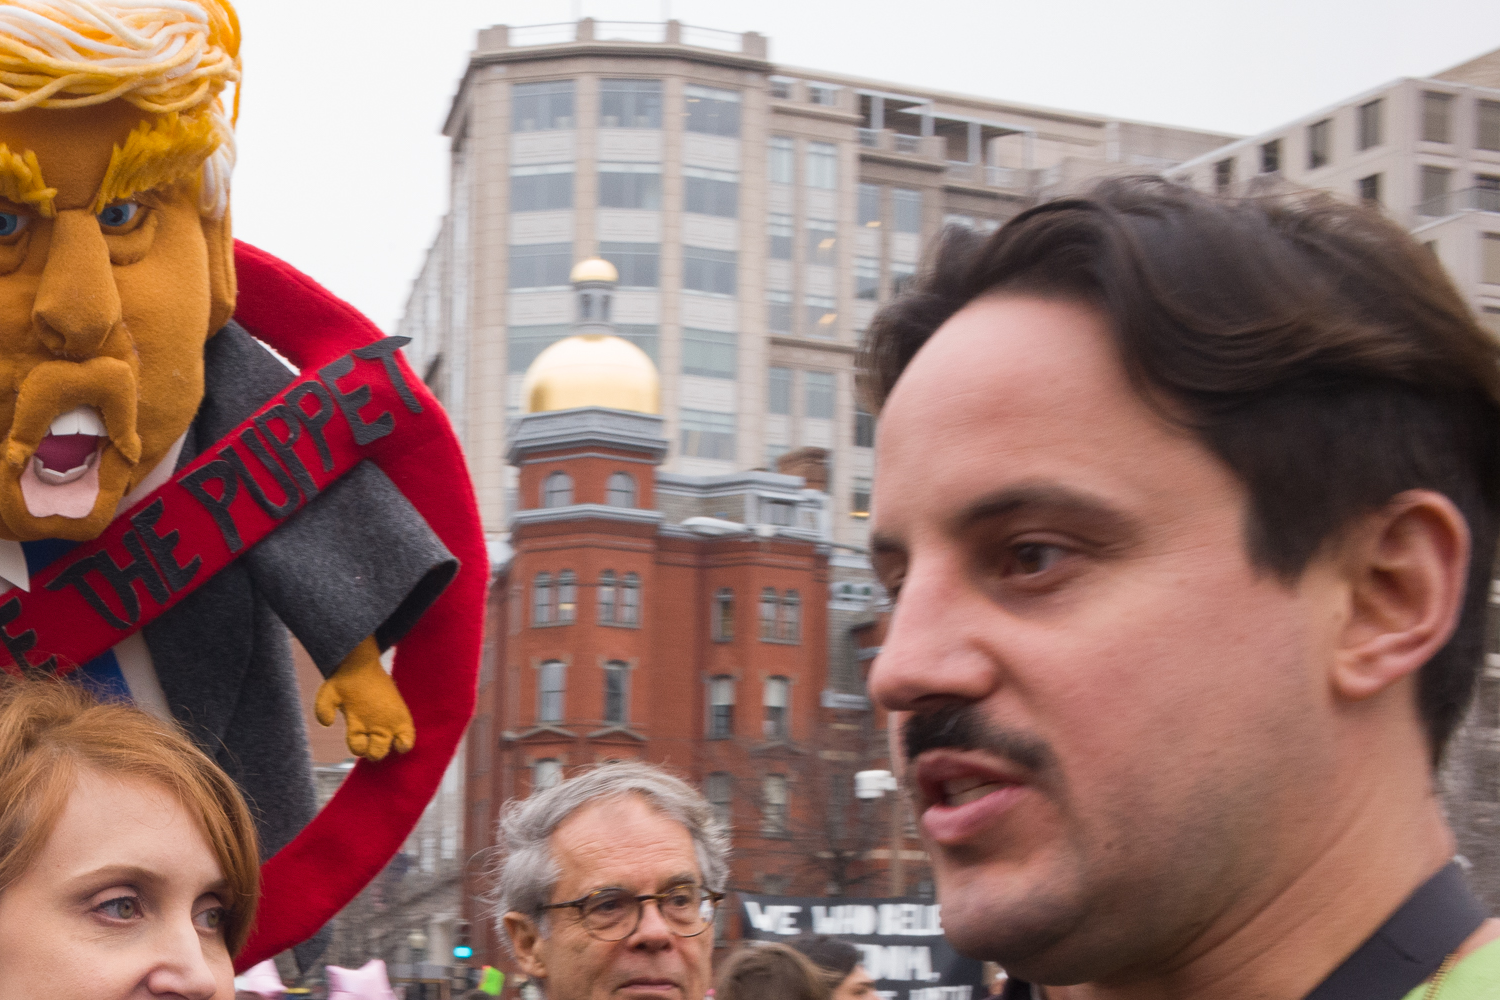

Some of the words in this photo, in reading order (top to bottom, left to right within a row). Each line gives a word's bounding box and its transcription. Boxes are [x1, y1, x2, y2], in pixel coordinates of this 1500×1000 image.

[44, 496, 203, 630] THE
[179, 336, 424, 553] PUPPET
[743, 901, 802, 936] WE
